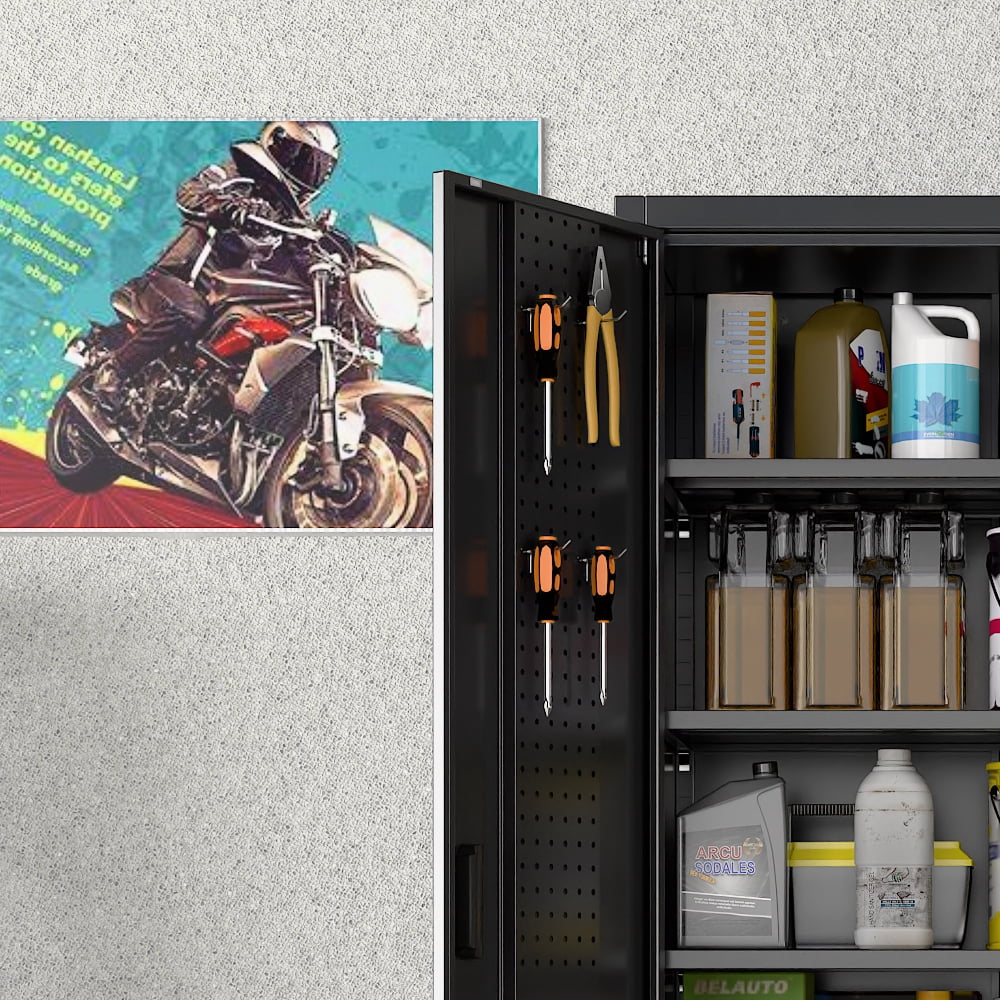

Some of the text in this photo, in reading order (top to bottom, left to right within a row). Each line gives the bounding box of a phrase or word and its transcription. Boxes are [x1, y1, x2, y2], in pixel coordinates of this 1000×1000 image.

[695, 845, 743, 860] ARCU
[695, 860, 756, 875] SODALES
[694, 981, 788, 994] BELAUTO
